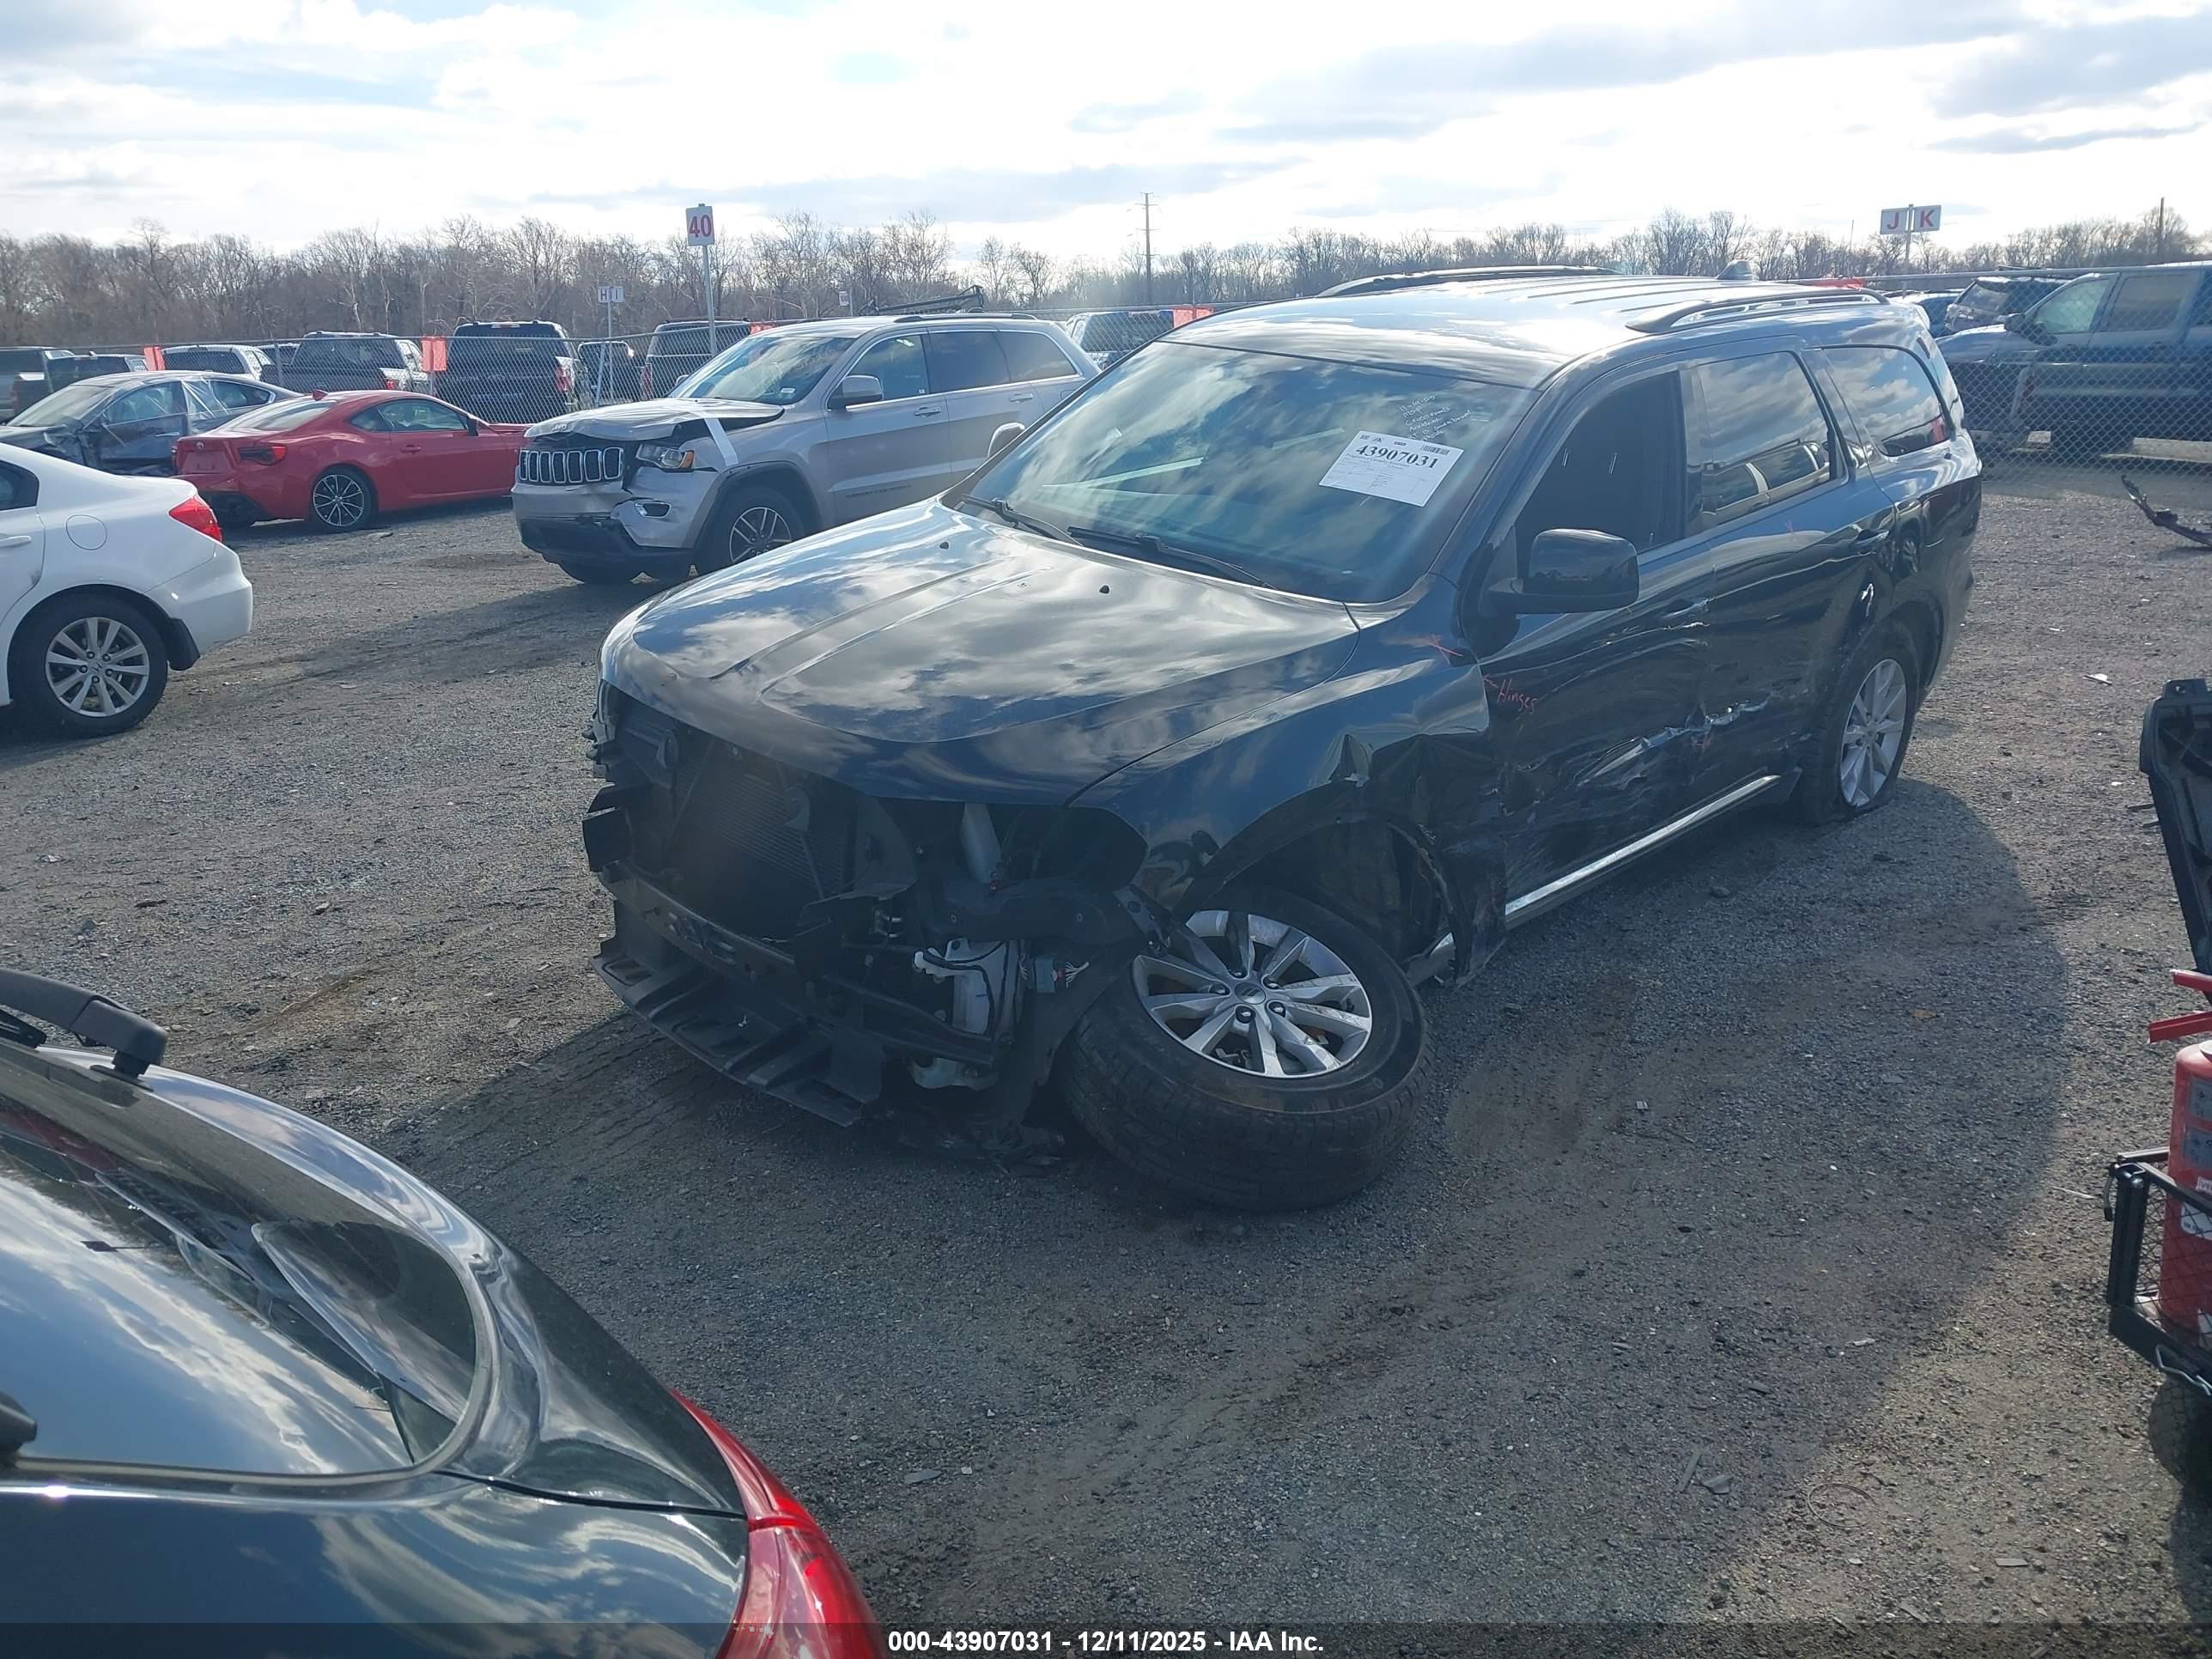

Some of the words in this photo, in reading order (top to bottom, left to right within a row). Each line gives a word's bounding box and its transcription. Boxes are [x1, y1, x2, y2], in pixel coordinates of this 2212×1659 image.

[689, 214, 712, 238] 40
[1887, 212, 1899, 229] J
[1919, 210, 1935, 228] K
[600, 288, 607, 301] H
[1355, 445, 1439, 469] 43907031
